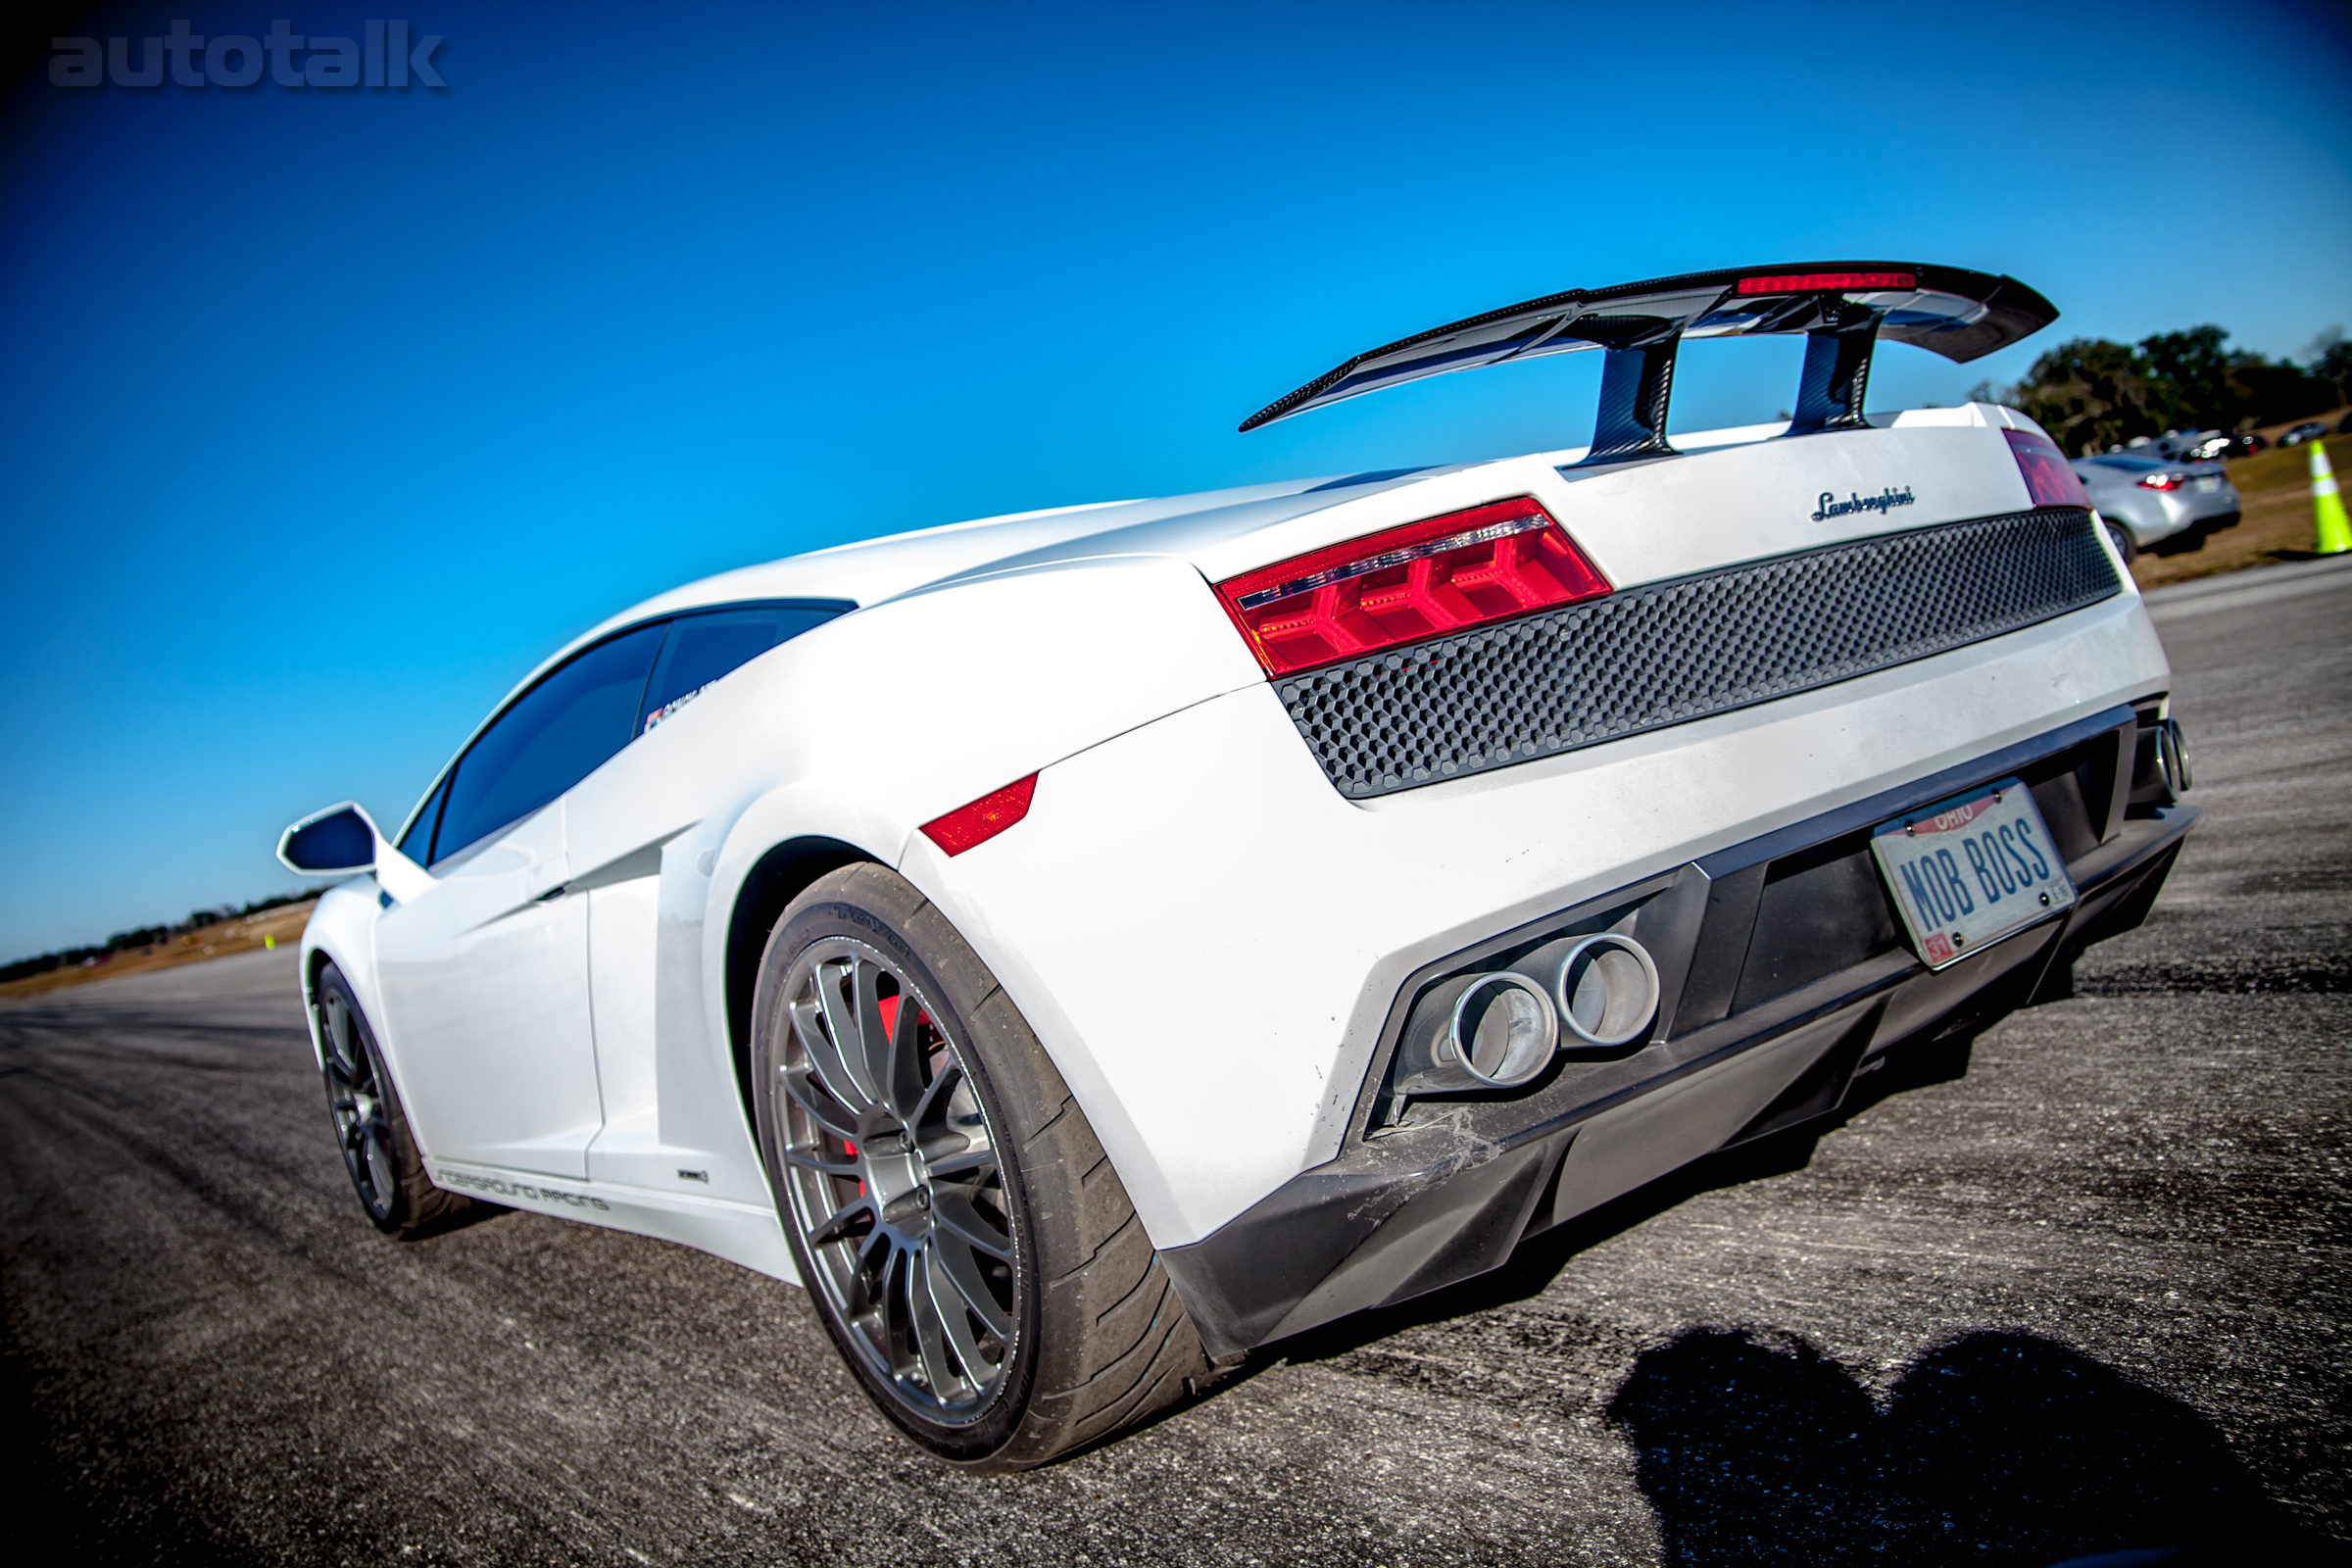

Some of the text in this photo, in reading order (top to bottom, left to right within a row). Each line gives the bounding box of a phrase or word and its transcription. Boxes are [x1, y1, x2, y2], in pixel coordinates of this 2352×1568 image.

[1810, 485, 1916, 521] Lamborghini
[1934, 804, 1974, 830] OHIO
[1899, 817, 2049, 931] MOB BOSS
[833, 905, 909, 956] TOYO
[1929, 937, 1948, 957] 31
